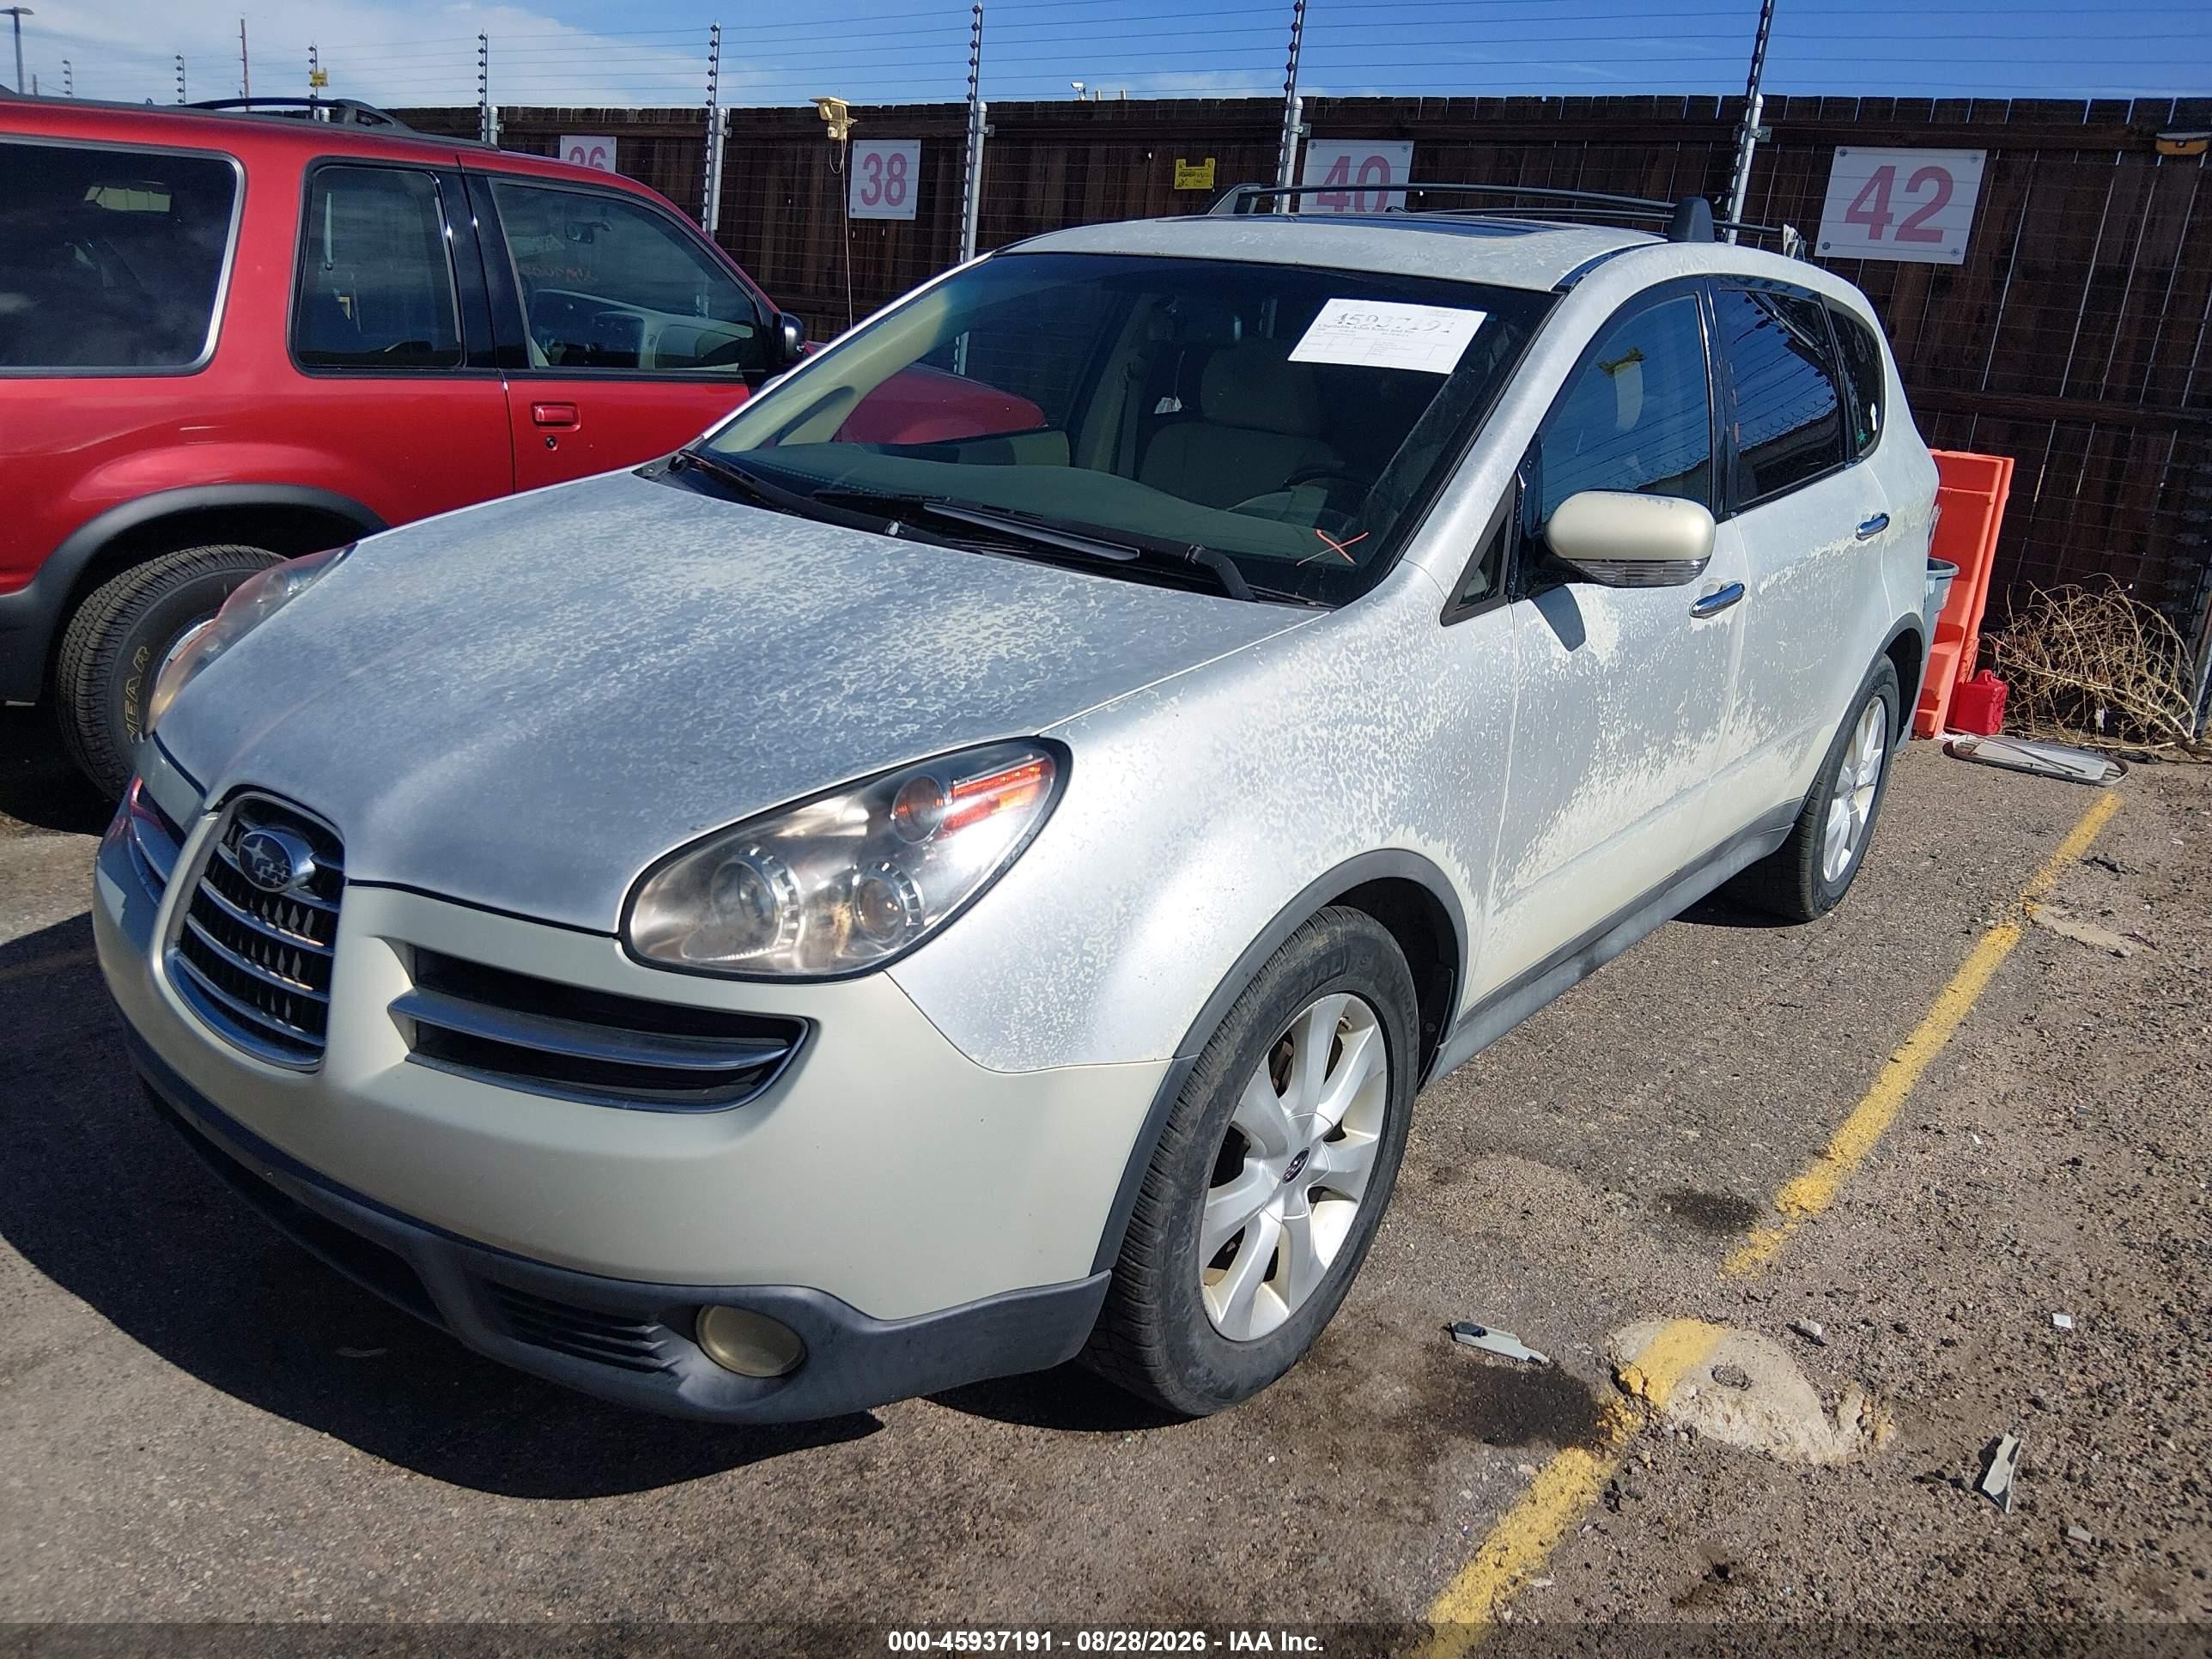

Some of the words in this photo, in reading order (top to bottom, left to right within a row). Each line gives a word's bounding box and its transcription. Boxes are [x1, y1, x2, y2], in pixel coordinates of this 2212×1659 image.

[861, 153, 907, 206] 38
[1317, 155, 1390, 212] 40
[1845, 166, 1954, 242] 42
